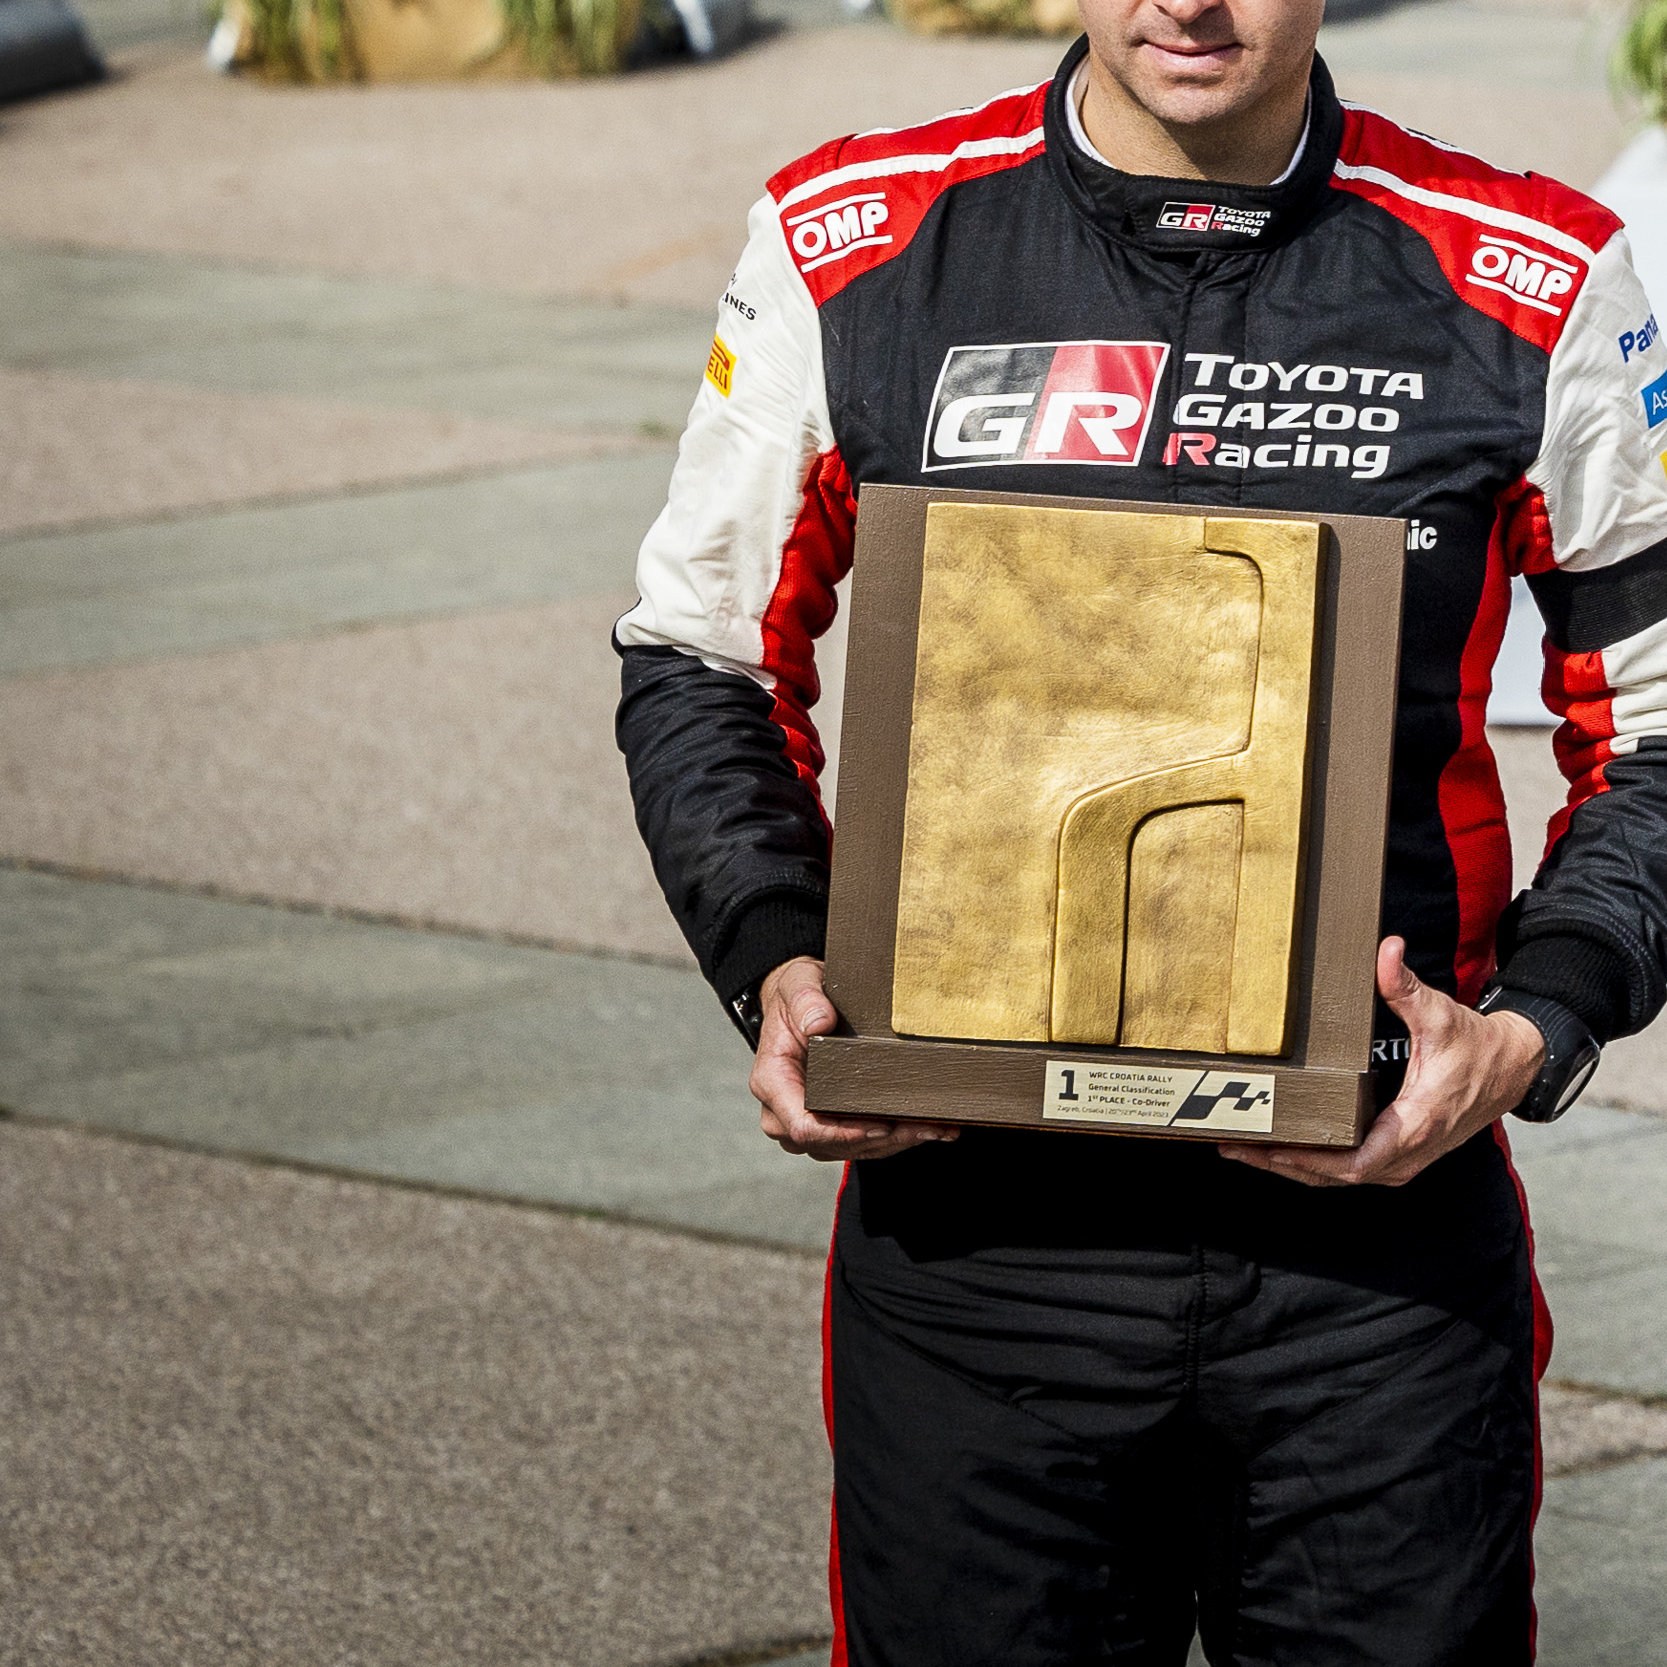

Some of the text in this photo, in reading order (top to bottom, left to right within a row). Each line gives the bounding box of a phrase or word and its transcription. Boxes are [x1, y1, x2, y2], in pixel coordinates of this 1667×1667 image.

[1160, 212, 1209, 229] GR
[1214, 213, 1265, 227] GAZOO
[1218, 205, 1272, 219] TOYOTA
[792, 201, 889, 259] OMP
[1210, 221, 1261, 237] Racing
[1471, 246, 1573, 301] OMP
[1184, 352, 1425, 401] TOYOTA
[933, 392, 1143, 458] GR
[1173, 393, 1401, 433] GAZOO
[1162, 432, 1391, 479] Racing
[1058, 1069, 1079, 1101] 1
[1088, 1071, 1173, 1083] WRC CROATIA RALLY
[1088, 1083, 1176, 1096] General Classification
[1099, 1096, 1125, 1104] PLACE
[1132, 1098, 1171, 1107] Co-Driver
